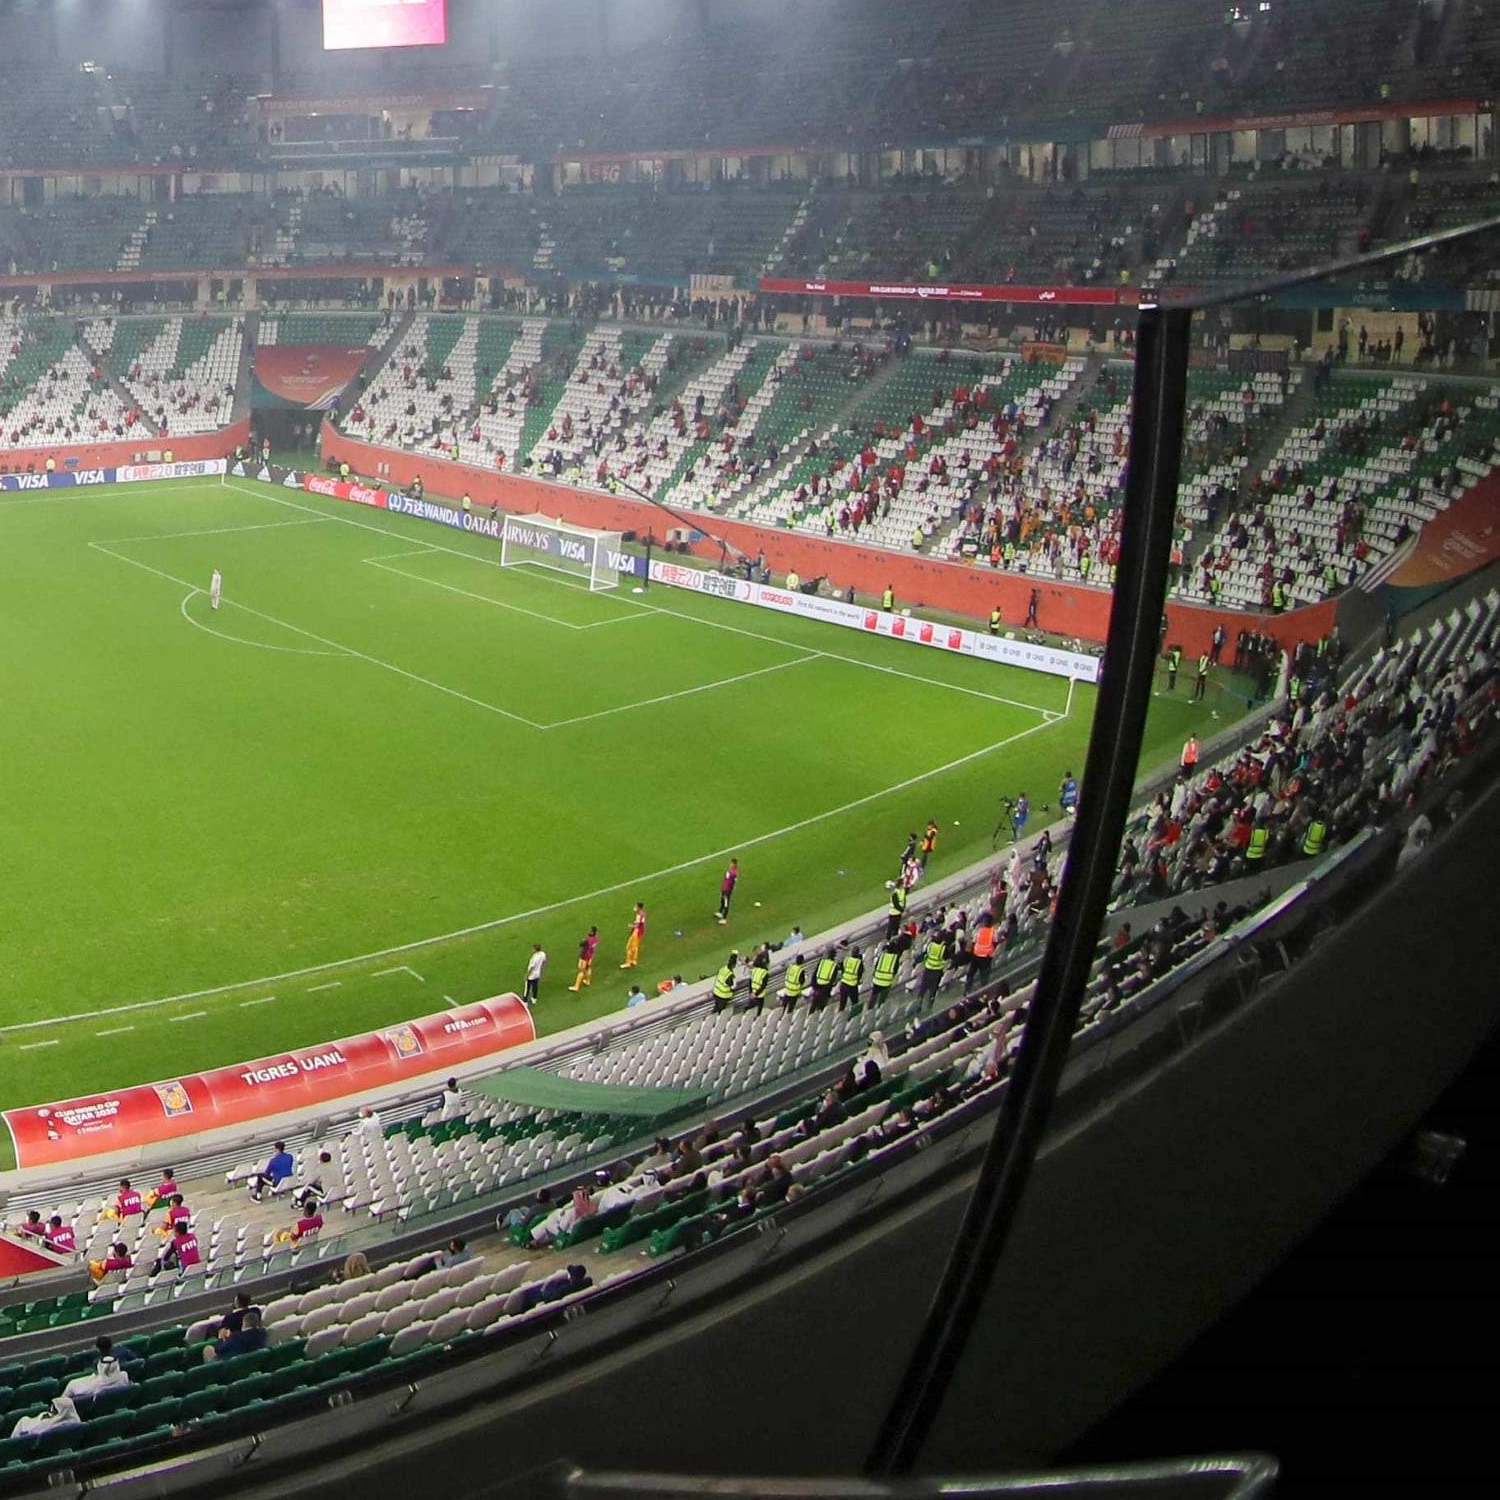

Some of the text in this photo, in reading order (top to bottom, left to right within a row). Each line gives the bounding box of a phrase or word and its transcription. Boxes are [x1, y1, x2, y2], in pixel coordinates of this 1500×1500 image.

[16, 474, 49, 489] VISA
[72, 469, 105, 485] VISA
[423, 503, 460, 526] WANDA
[462, 513, 498, 537] QATAR
[559, 538, 586, 561] VISA
[607, 550, 636, 573] VISA
[241, 1052, 347, 1086] TIGRES UANL
[54, 1100, 120, 1118] CLUB WORLD CUP
[63, 1112, 95, 1126] QATAR
[95, 1107, 118, 1119] 2020
[124, 1196, 140, 1206] FIFA
[53, 1231, 72, 1243] FIFA
[181, 1239, 197, 1252] FIFA
